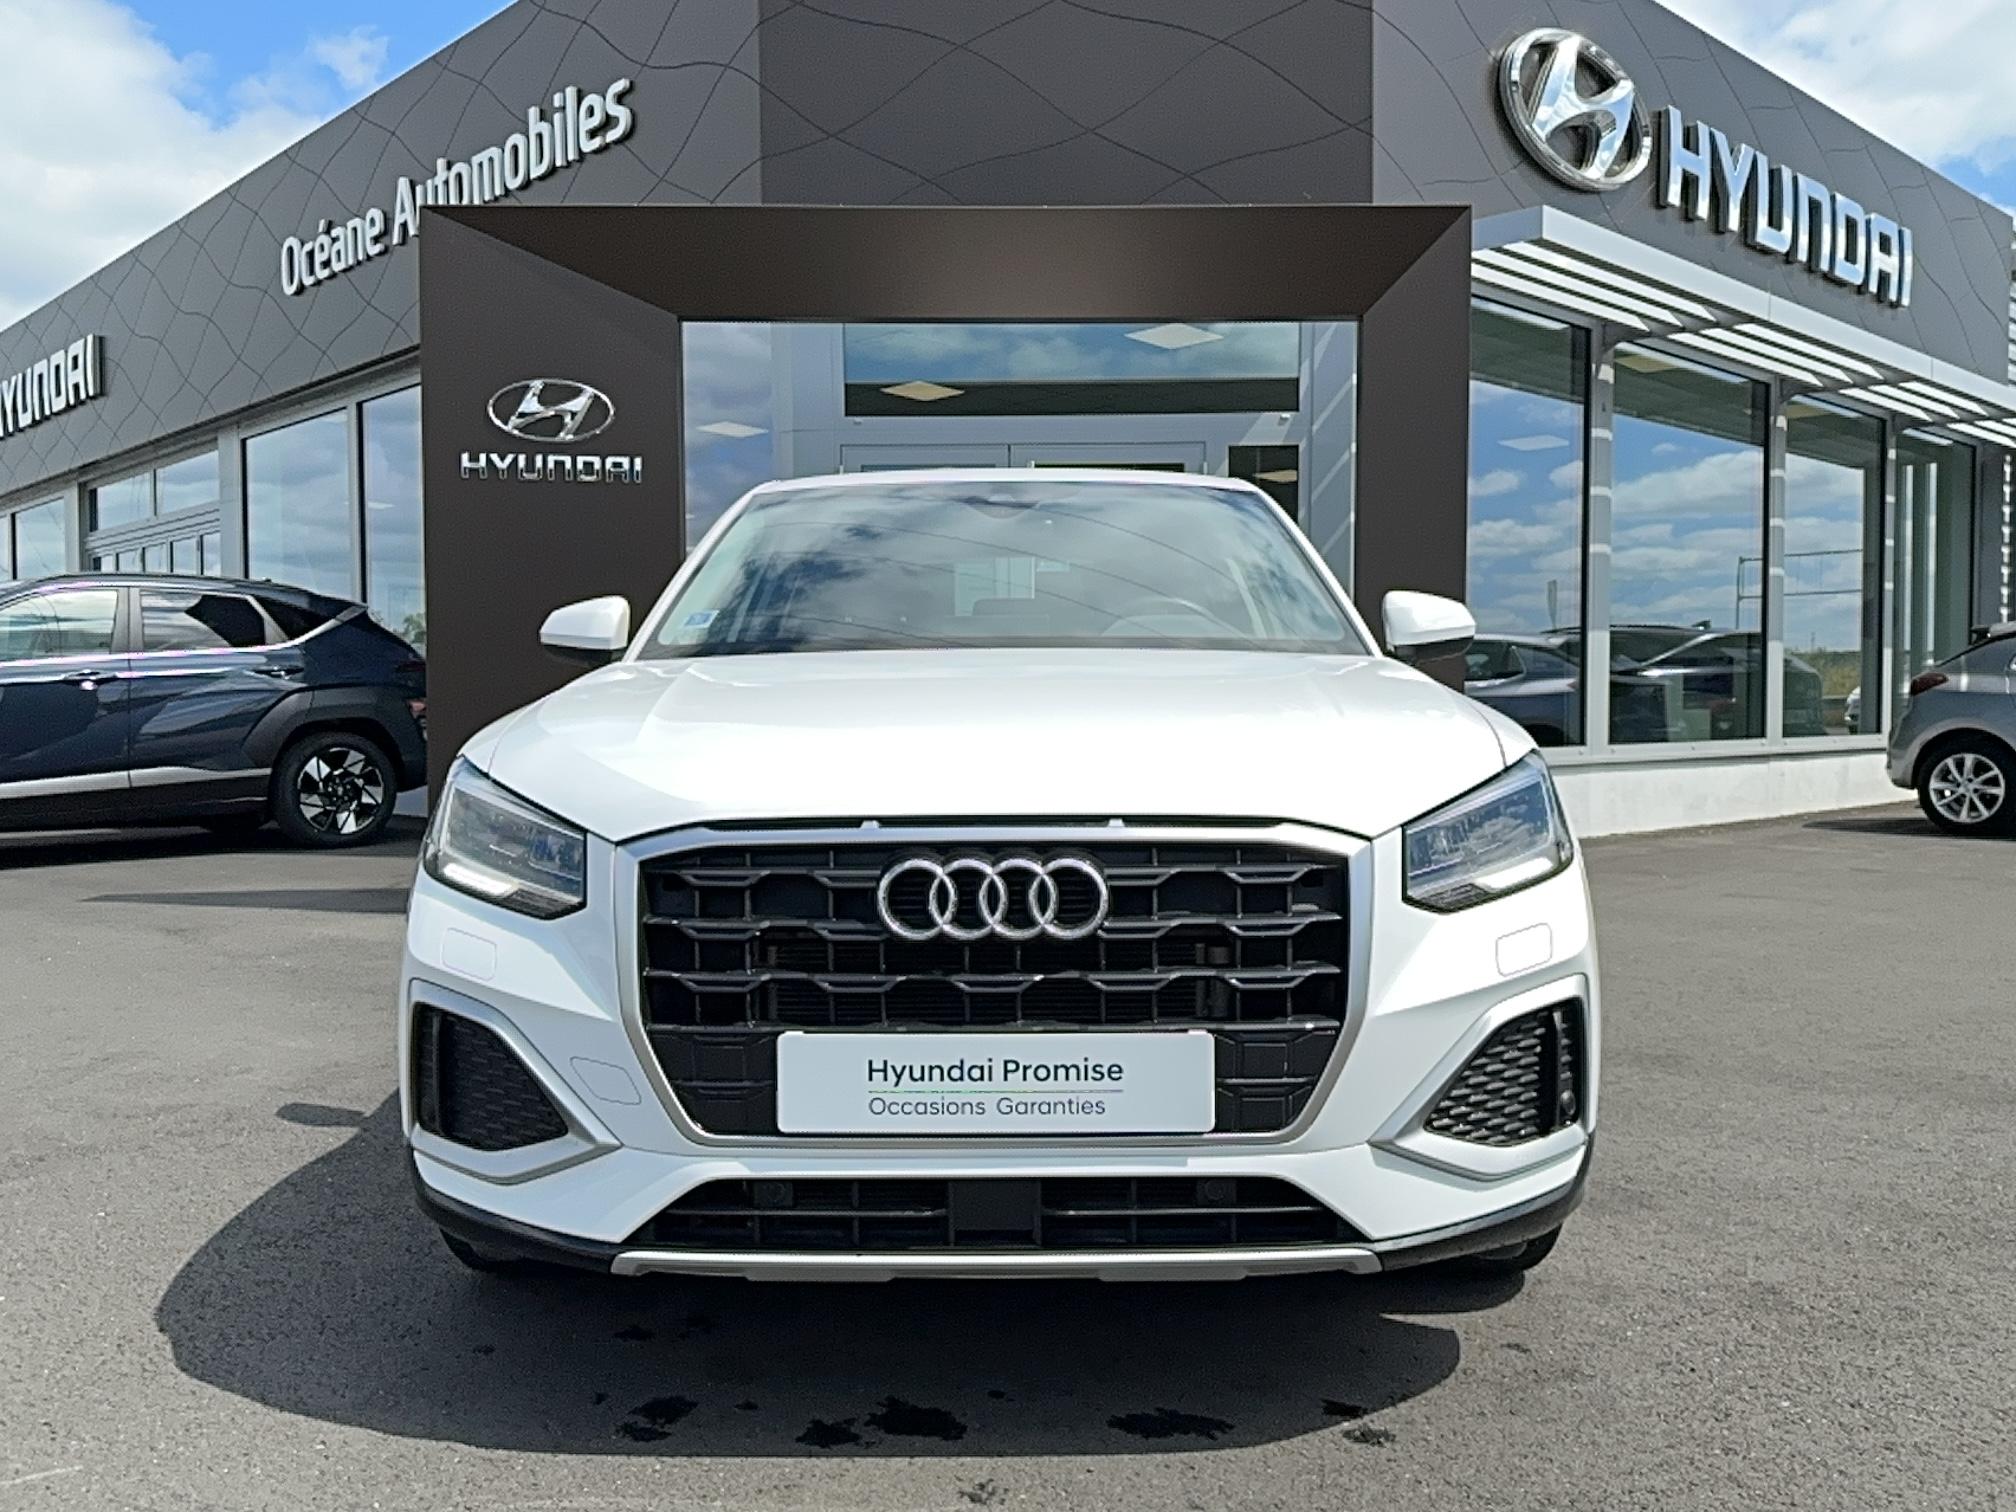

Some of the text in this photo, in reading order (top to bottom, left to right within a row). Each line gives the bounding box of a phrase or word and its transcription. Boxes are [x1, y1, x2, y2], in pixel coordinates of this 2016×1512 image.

[1662, 104, 1914, 308] HYUNDAI
[281, 207, 386, 296] Océane
[0, 333, 97, 437] YUNDAI
[460, 451, 643, 483] HYUNDAI
[867, 1057, 1124, 1088] Hyundai Promise
[868, 1096, 1106, 1116] Occasions Garanties
